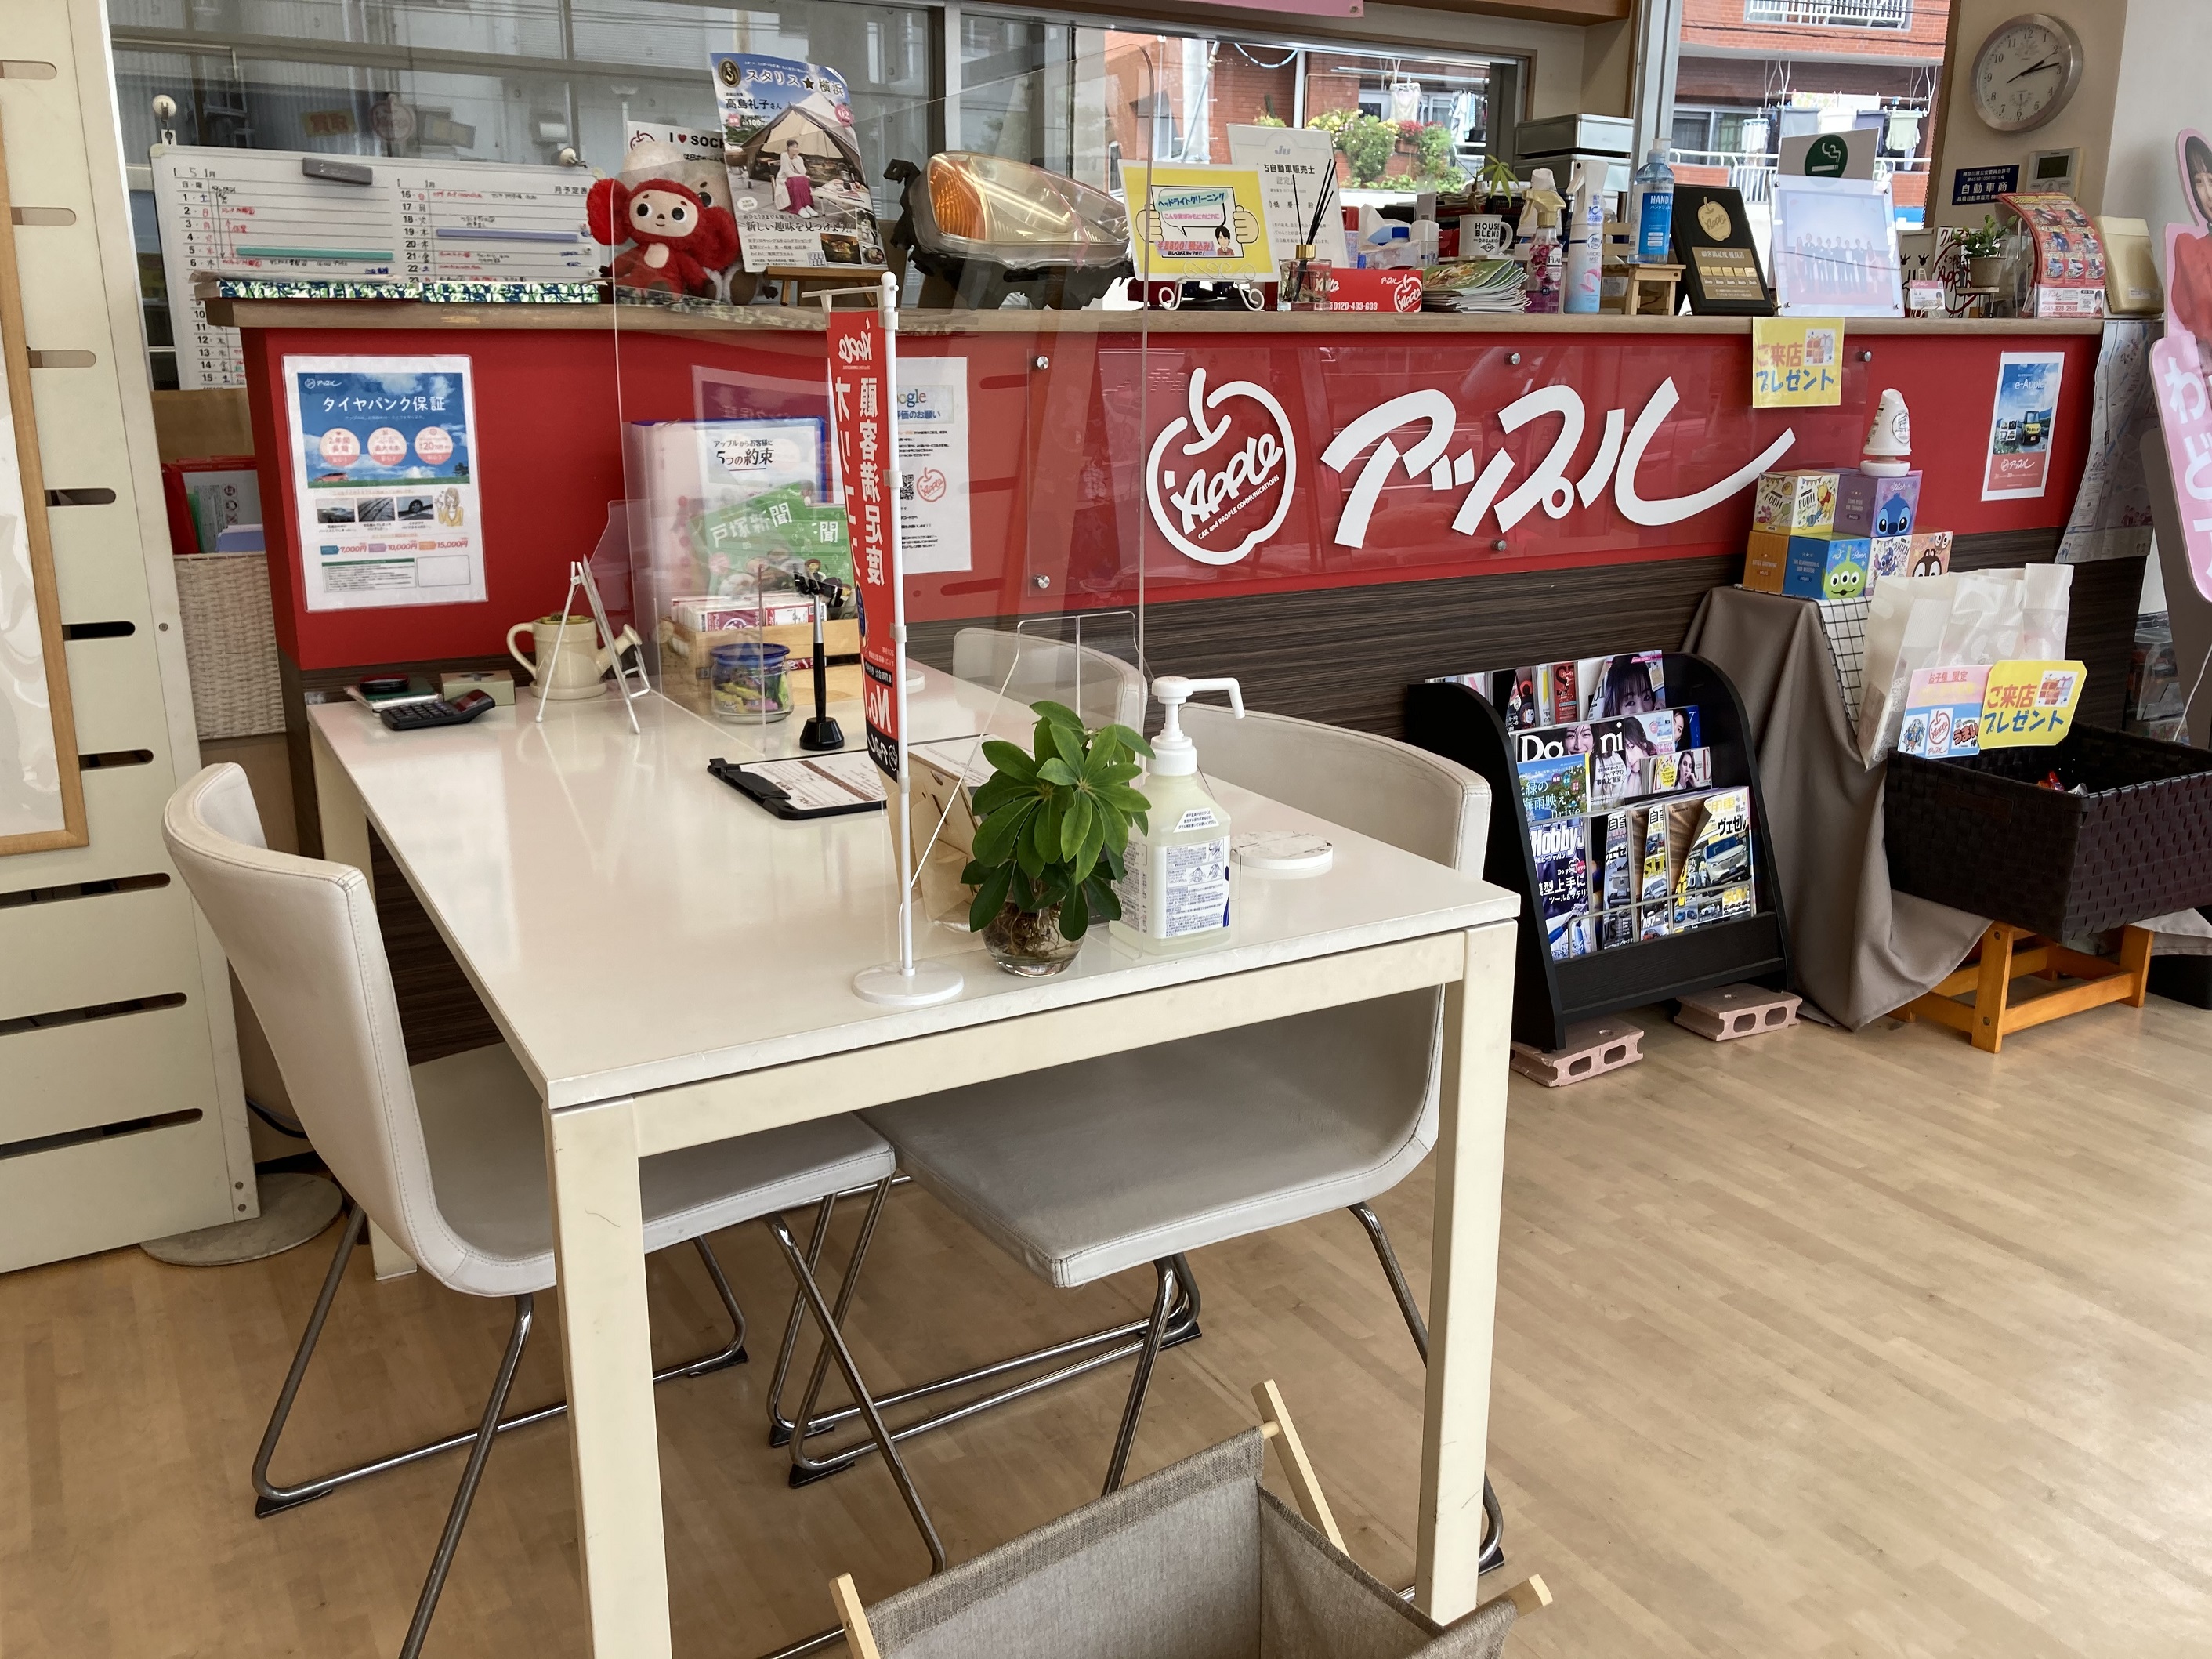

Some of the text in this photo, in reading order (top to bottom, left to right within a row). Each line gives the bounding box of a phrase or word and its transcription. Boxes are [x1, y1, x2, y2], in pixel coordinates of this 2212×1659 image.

[2024, 30, 2033, 39] 12
[2043, 34, 2047, 42] 1
[2007, 38, 2016, 48] 11
[2053, 45, 2058, 54] 2
[1994, 54, 2004, 63] 10
[2057, 66, 2062, 75] 3
[1987, 73, 1992, 82] 9
[1991, 92, 1997, 100] 8
[2047, 87, 2054, 96] 4
[726, 99, 782, 110] 高島礼子さん
[2034, 102, 2040, 110] 5
[2016, 108, 2022, 118] 6
[669, 132, 673, 142] I
[1961, 181, 2007, 194] 自動車商
[1158, 193, 1225, 207] ヘッドライトクリーニング
[184, 206, 190, 215] 2
[186, 219, 191, 228] 3
[189, 245, 195, 254] 5
[190, 259, 196, 267] 6
[1757, 343, 1803, 367] ご来店
[1756, 368, 1834, 393] プレゼント
[2015, 379, 2045, 390] e-Apple
[322, 396, 446, 412] タイヤパンク保証
[713, 439, 773, 447] アップルからお客様に
[716, 447, 774, 466] 5つの約束
[1321, 376, 1796, 549] アップル
[1764, 493, 1783, 509] POOH
[1798, 493, 1816, 509] POOH
[1197, 474, 1280, 540] CAR and PEOPLE COMMUNICATIONS
[437, 540, 468, 549] 15,000円
[1986, 685, 2037, 708] ご来店
[1983, 709, 2064, 735] プレゼント
[1551, 808, 1580, 819] Drive
[1718, 813, 1747, 836] ヴェゼル
[1723, 887, 1747, 904] SUV
